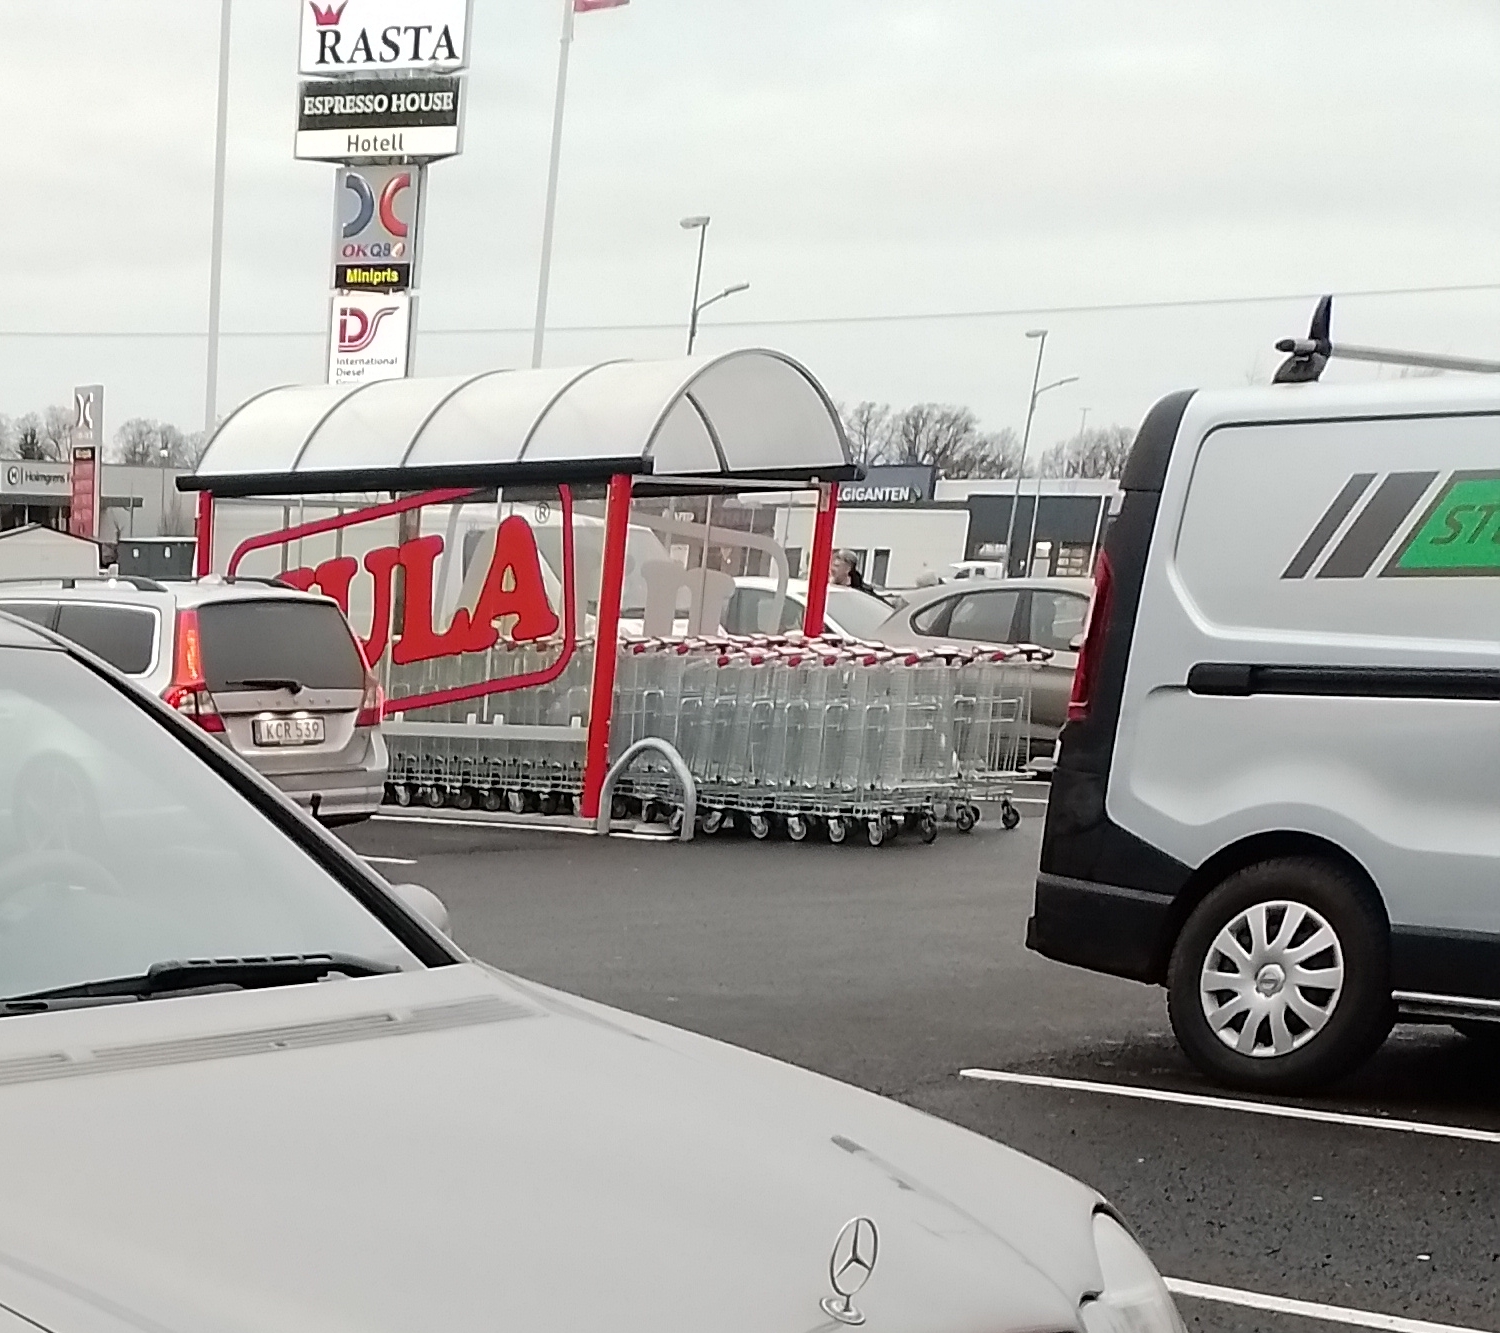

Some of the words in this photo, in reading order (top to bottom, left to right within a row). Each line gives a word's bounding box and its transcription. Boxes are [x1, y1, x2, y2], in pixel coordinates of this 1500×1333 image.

[315, 24, 460, 65] RASTA
[303, 94, 388, 116] ESPRESSO
[390, 91, 454, 113] HOUSE
[346, 133, 404, 153] Hotell
[346, 267, 400, 285] Minipris
[336, 356, 398, 366] International
[336, 367, 365, 377] Diesel
[837, 486, 909, 502] LGIGANTEN
[274, 515, 559, 671] ULA
[266, 721, 292, 740] KCR
[296, 721, 320, 739] 539
